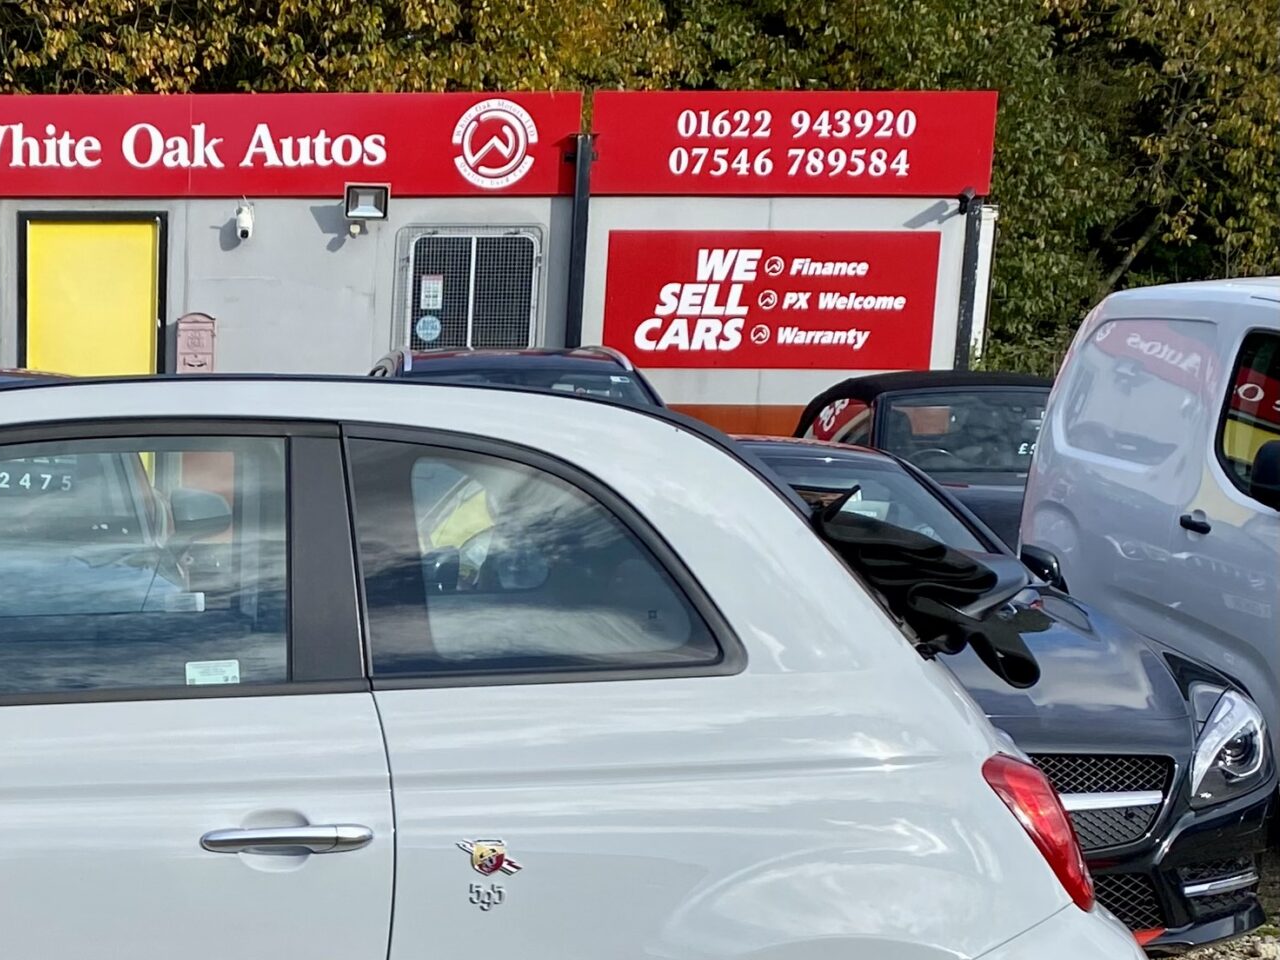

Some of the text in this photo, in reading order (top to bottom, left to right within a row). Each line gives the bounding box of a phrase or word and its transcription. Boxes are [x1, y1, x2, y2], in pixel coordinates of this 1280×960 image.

[677, 109, 917, 139] 01622 943920
[121, 122, 225, 169] Oak
[240, 123, 387, 168] Autos
[668, 147, 910, 177] 07546 789584
[696, 248, 763, 282] WE
[789, 257, 869, 277] Finance
[654, 282, 749, 316] SELL
[782, 292, 907, 310] PX Welcome
[634, 317, 744, 352] CARS
[776, 326, 870, 350] Warranty
